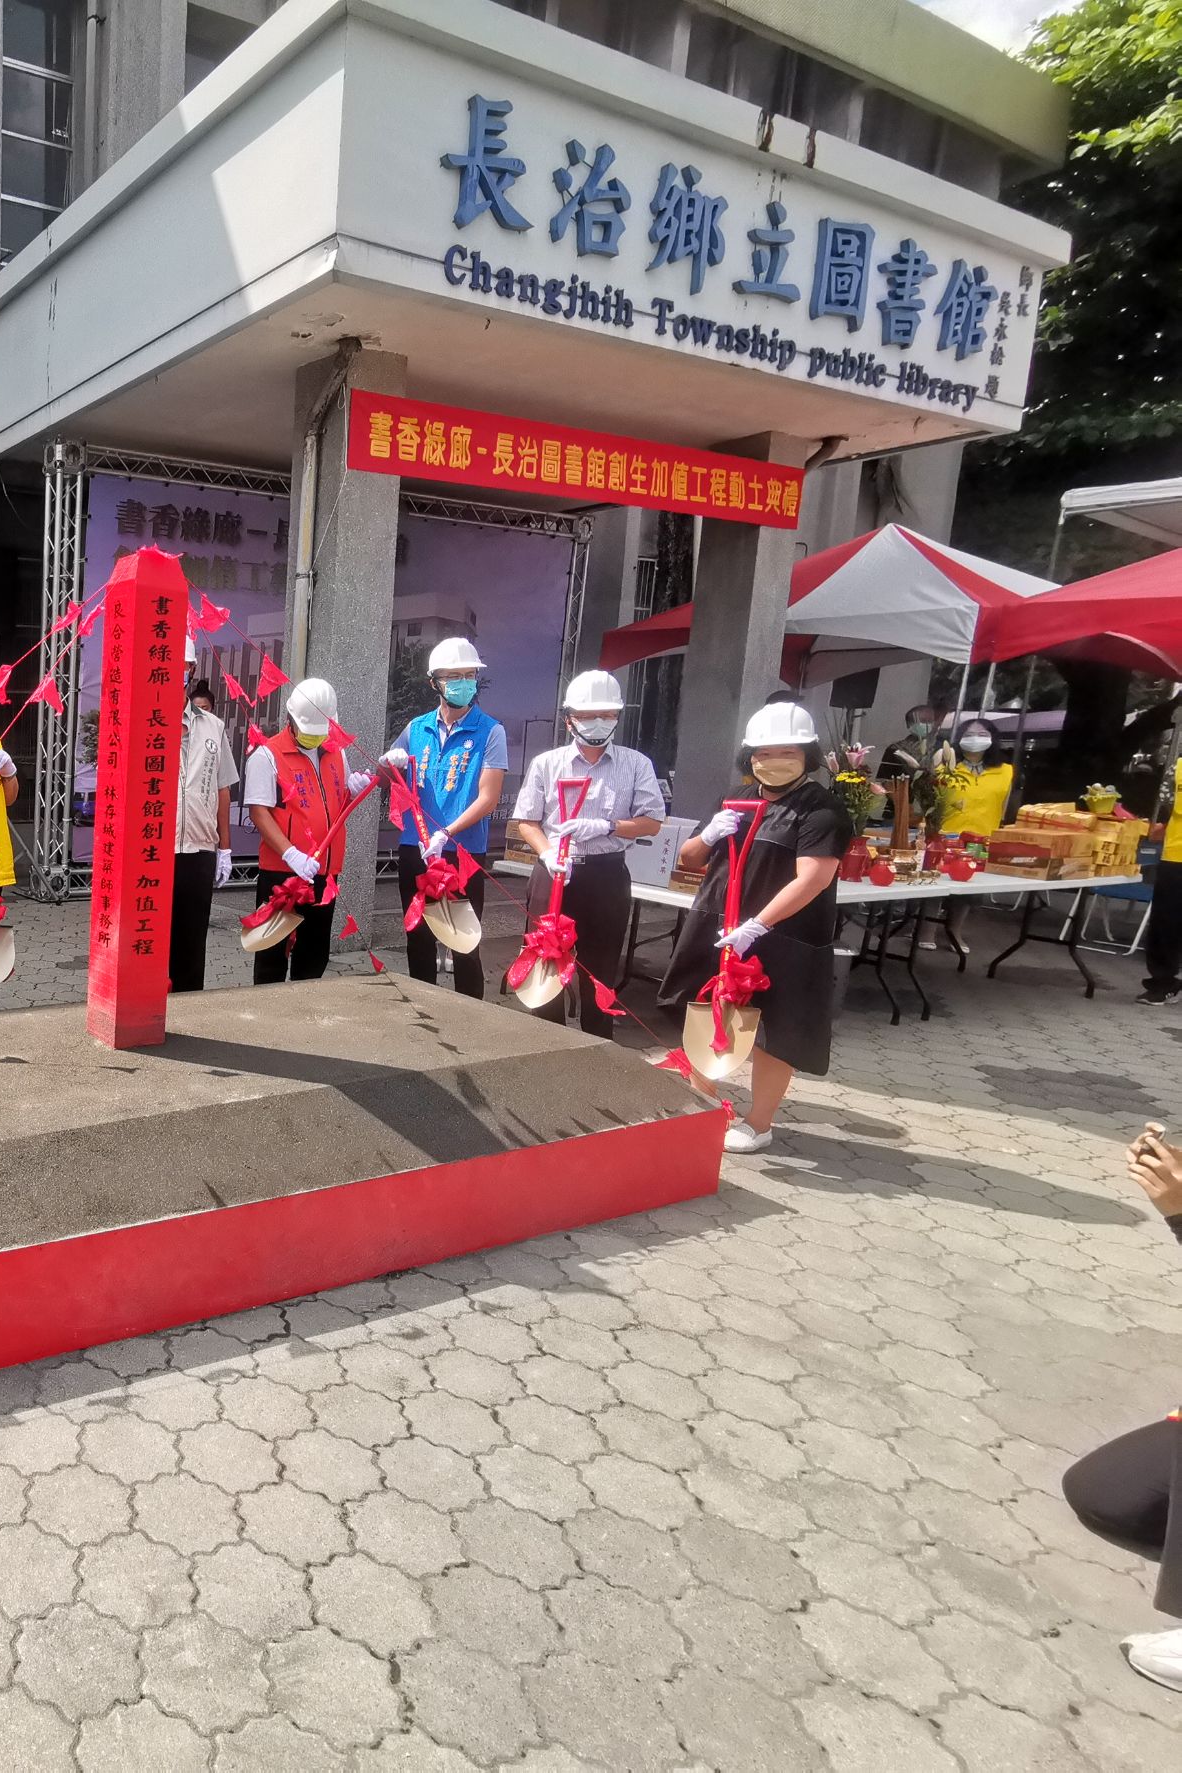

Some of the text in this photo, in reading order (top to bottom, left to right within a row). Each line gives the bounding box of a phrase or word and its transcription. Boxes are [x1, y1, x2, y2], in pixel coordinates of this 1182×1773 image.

[440, 94, 999, 362] 長治鄉立圖書館
[444, 244, 980, 412] Changjhih Township public library
